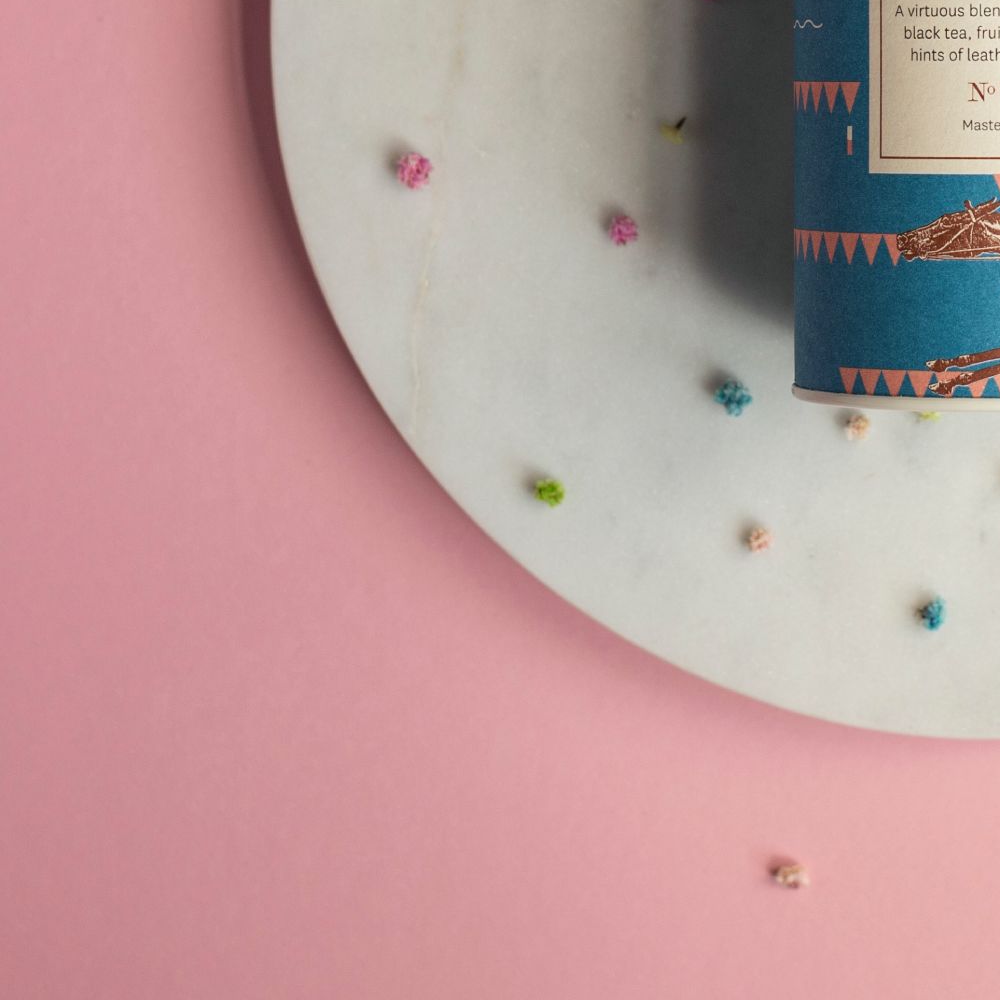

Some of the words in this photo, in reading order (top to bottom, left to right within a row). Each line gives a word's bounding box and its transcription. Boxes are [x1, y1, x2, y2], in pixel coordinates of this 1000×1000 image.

[894, 4, 905, 17] A
[908, 3, 965, 17] virtuous
[904, 26, 940, 40] black
[944, 27, 972, 42] tea,
[910, 48, 945, 62] hints
[949, 47, 964, 62] of
